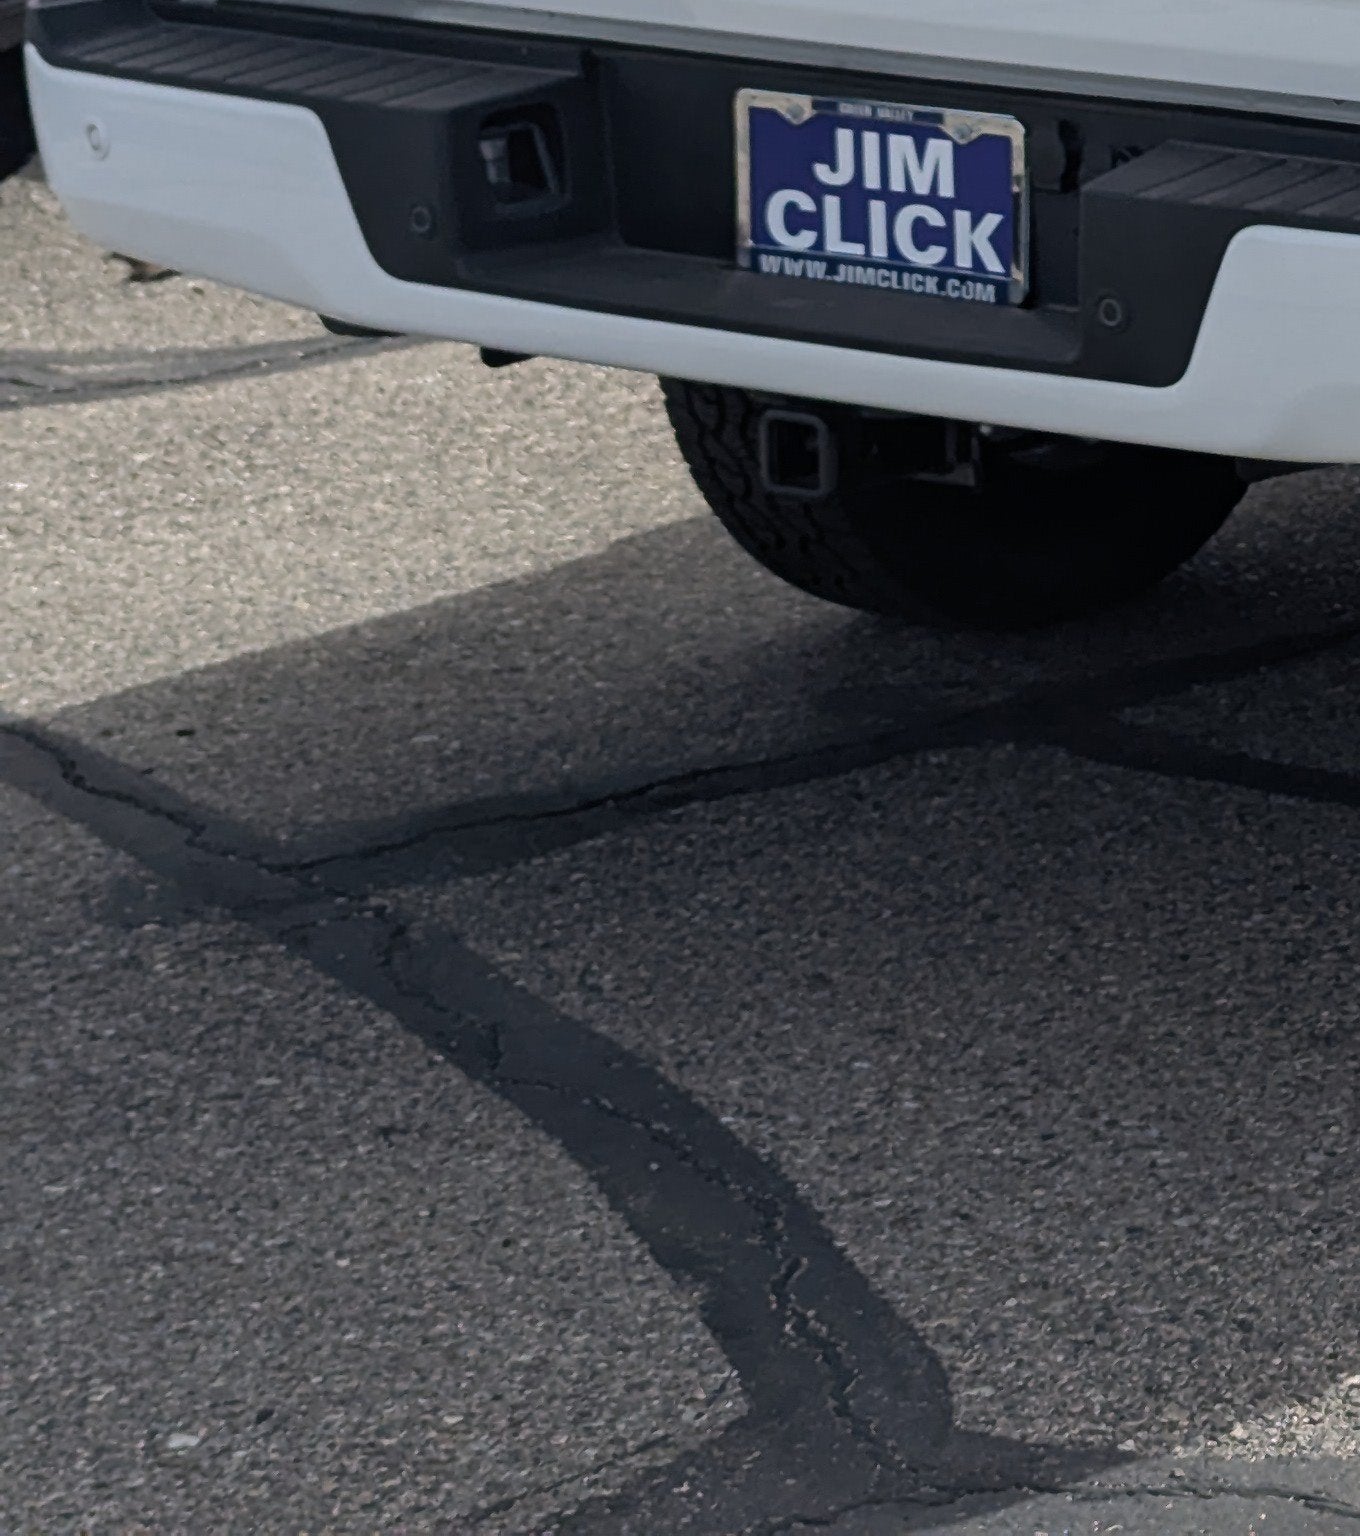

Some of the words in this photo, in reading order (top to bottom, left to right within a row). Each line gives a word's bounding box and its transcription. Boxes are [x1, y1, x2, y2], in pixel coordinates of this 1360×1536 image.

[812, 126, 955, 199] JIM
[764, 188, 1005, 274] CLICK
[758, 253, 997, 304] WWW.JIMCLICK.COM
